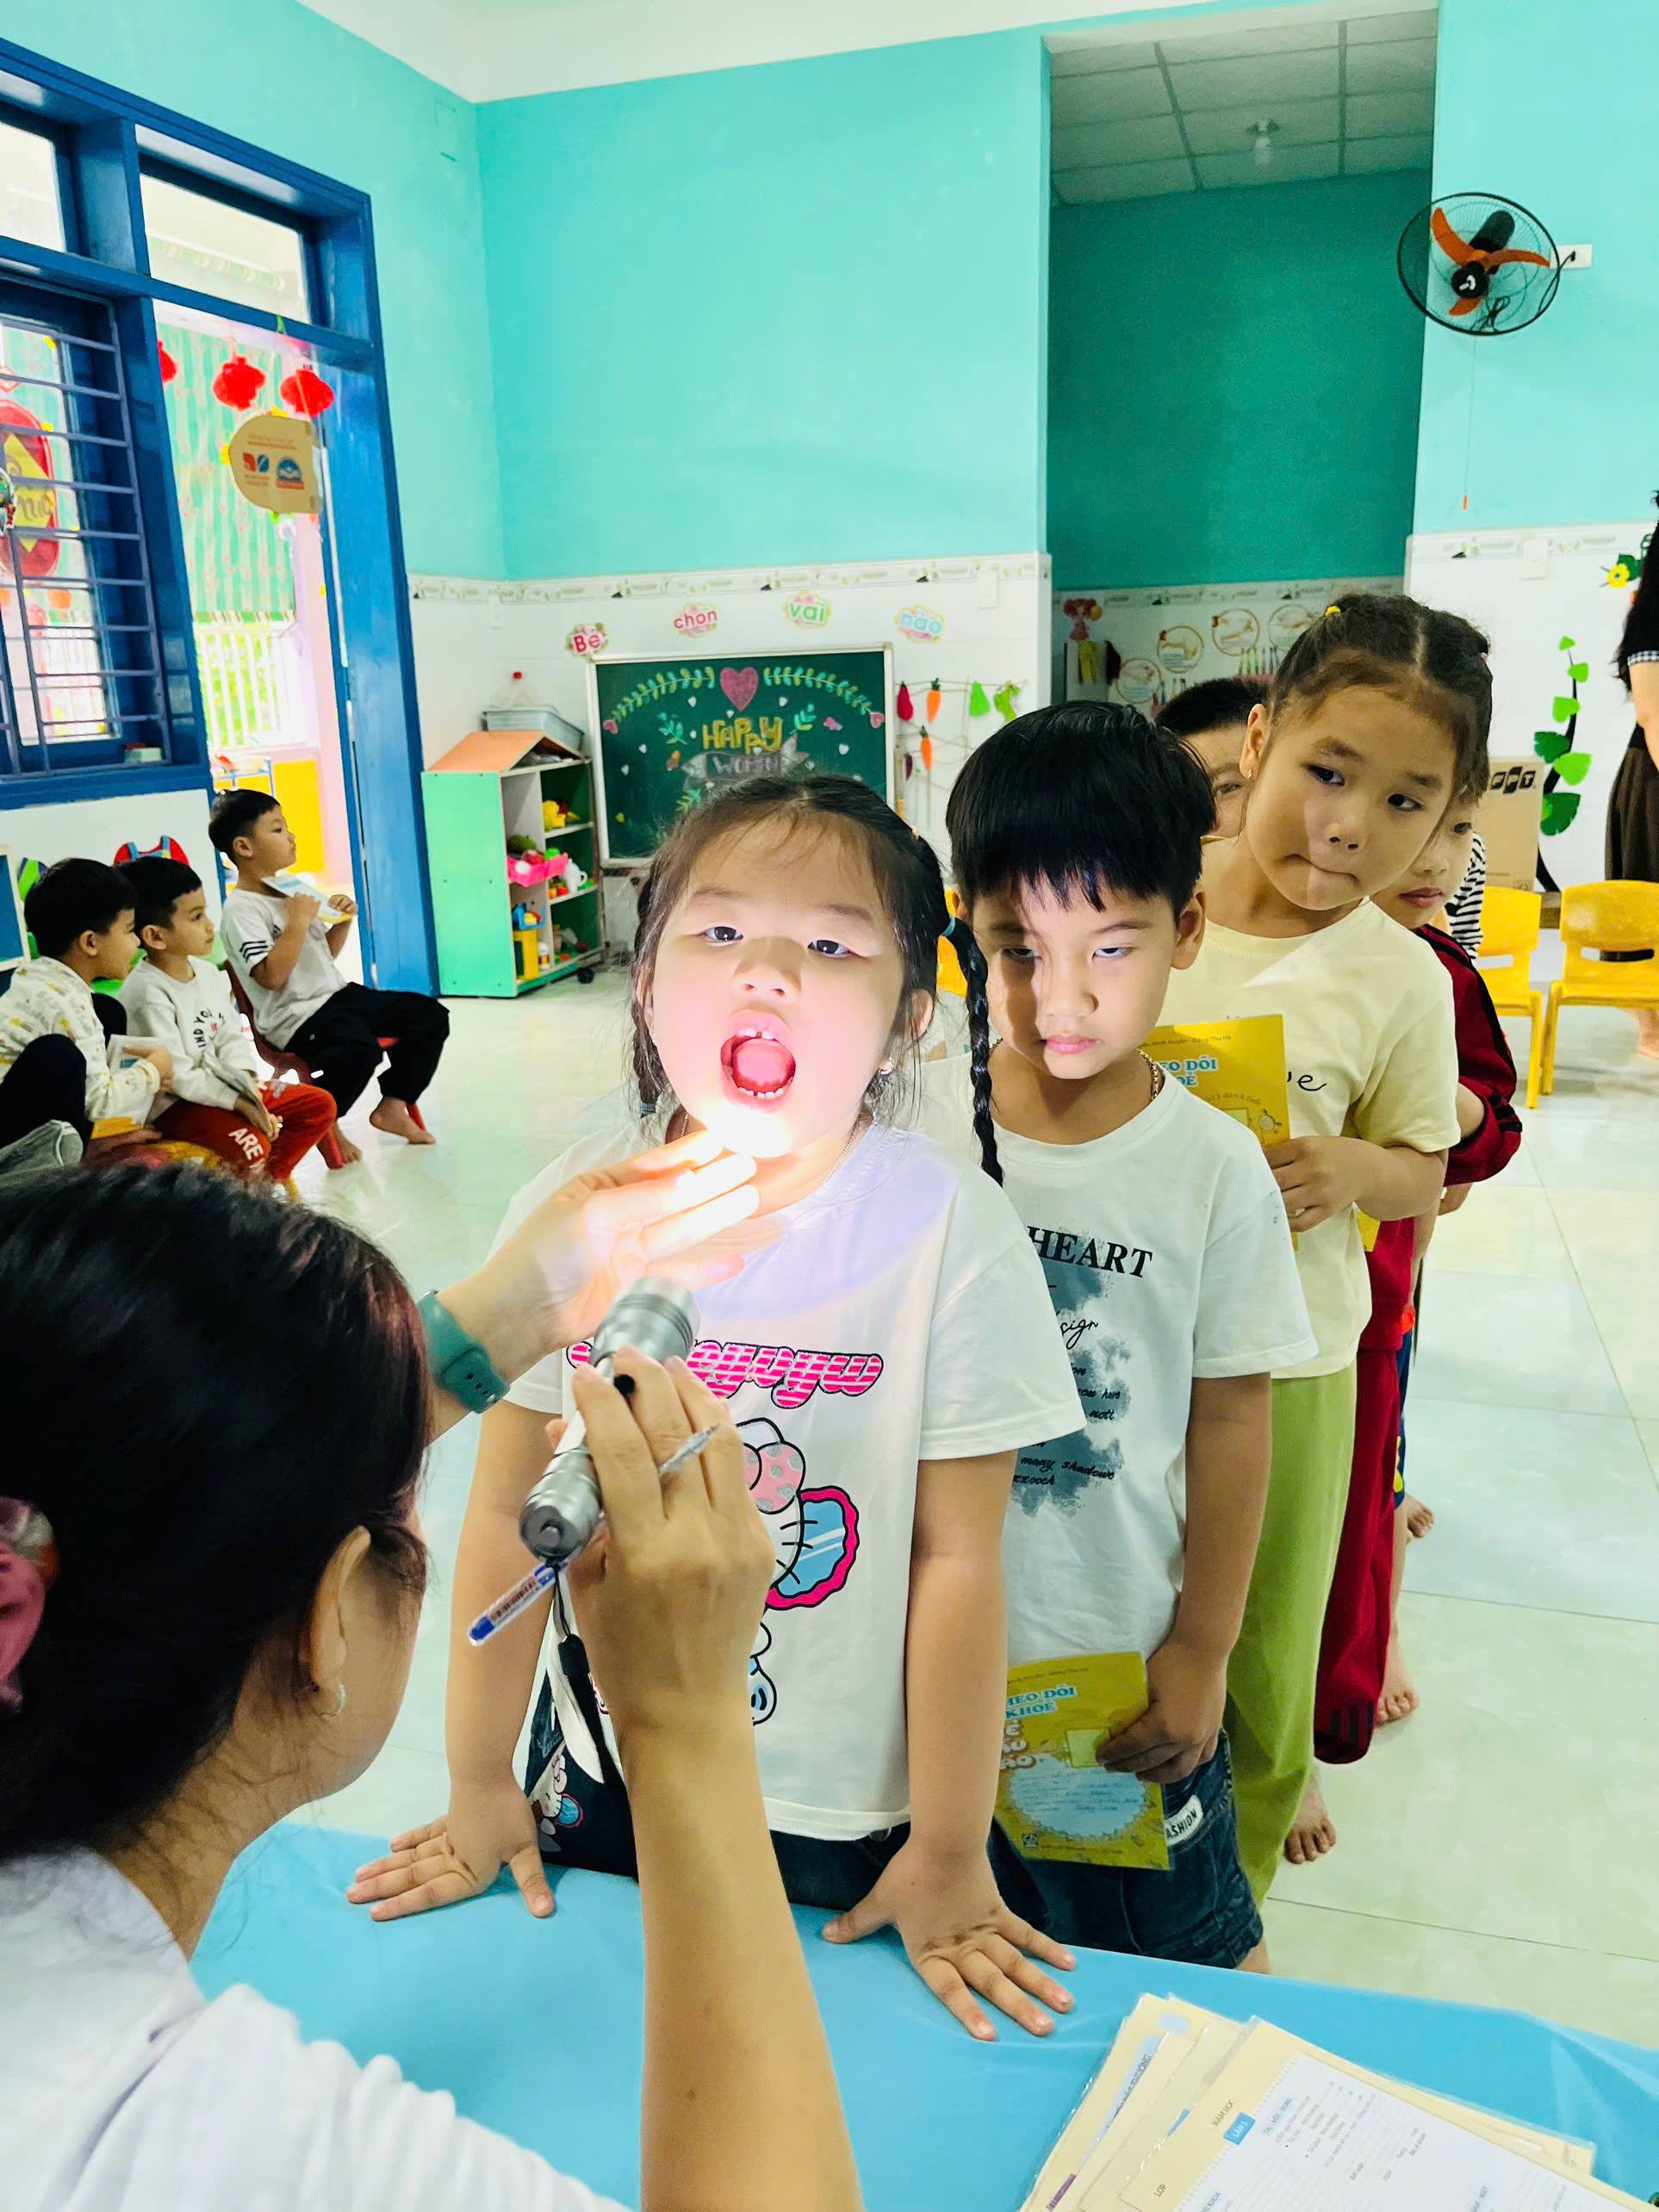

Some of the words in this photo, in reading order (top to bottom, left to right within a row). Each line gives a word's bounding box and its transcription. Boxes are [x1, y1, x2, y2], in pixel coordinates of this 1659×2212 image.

[790, 601, 826, 622] vai
[702, 717, 783, 755] HAPPY
[1489, 766, 1536, 794] FPT
[1027, 1226, 1153, 1277] HEART
[1165, 1809, 1197, 1839] ASHION
